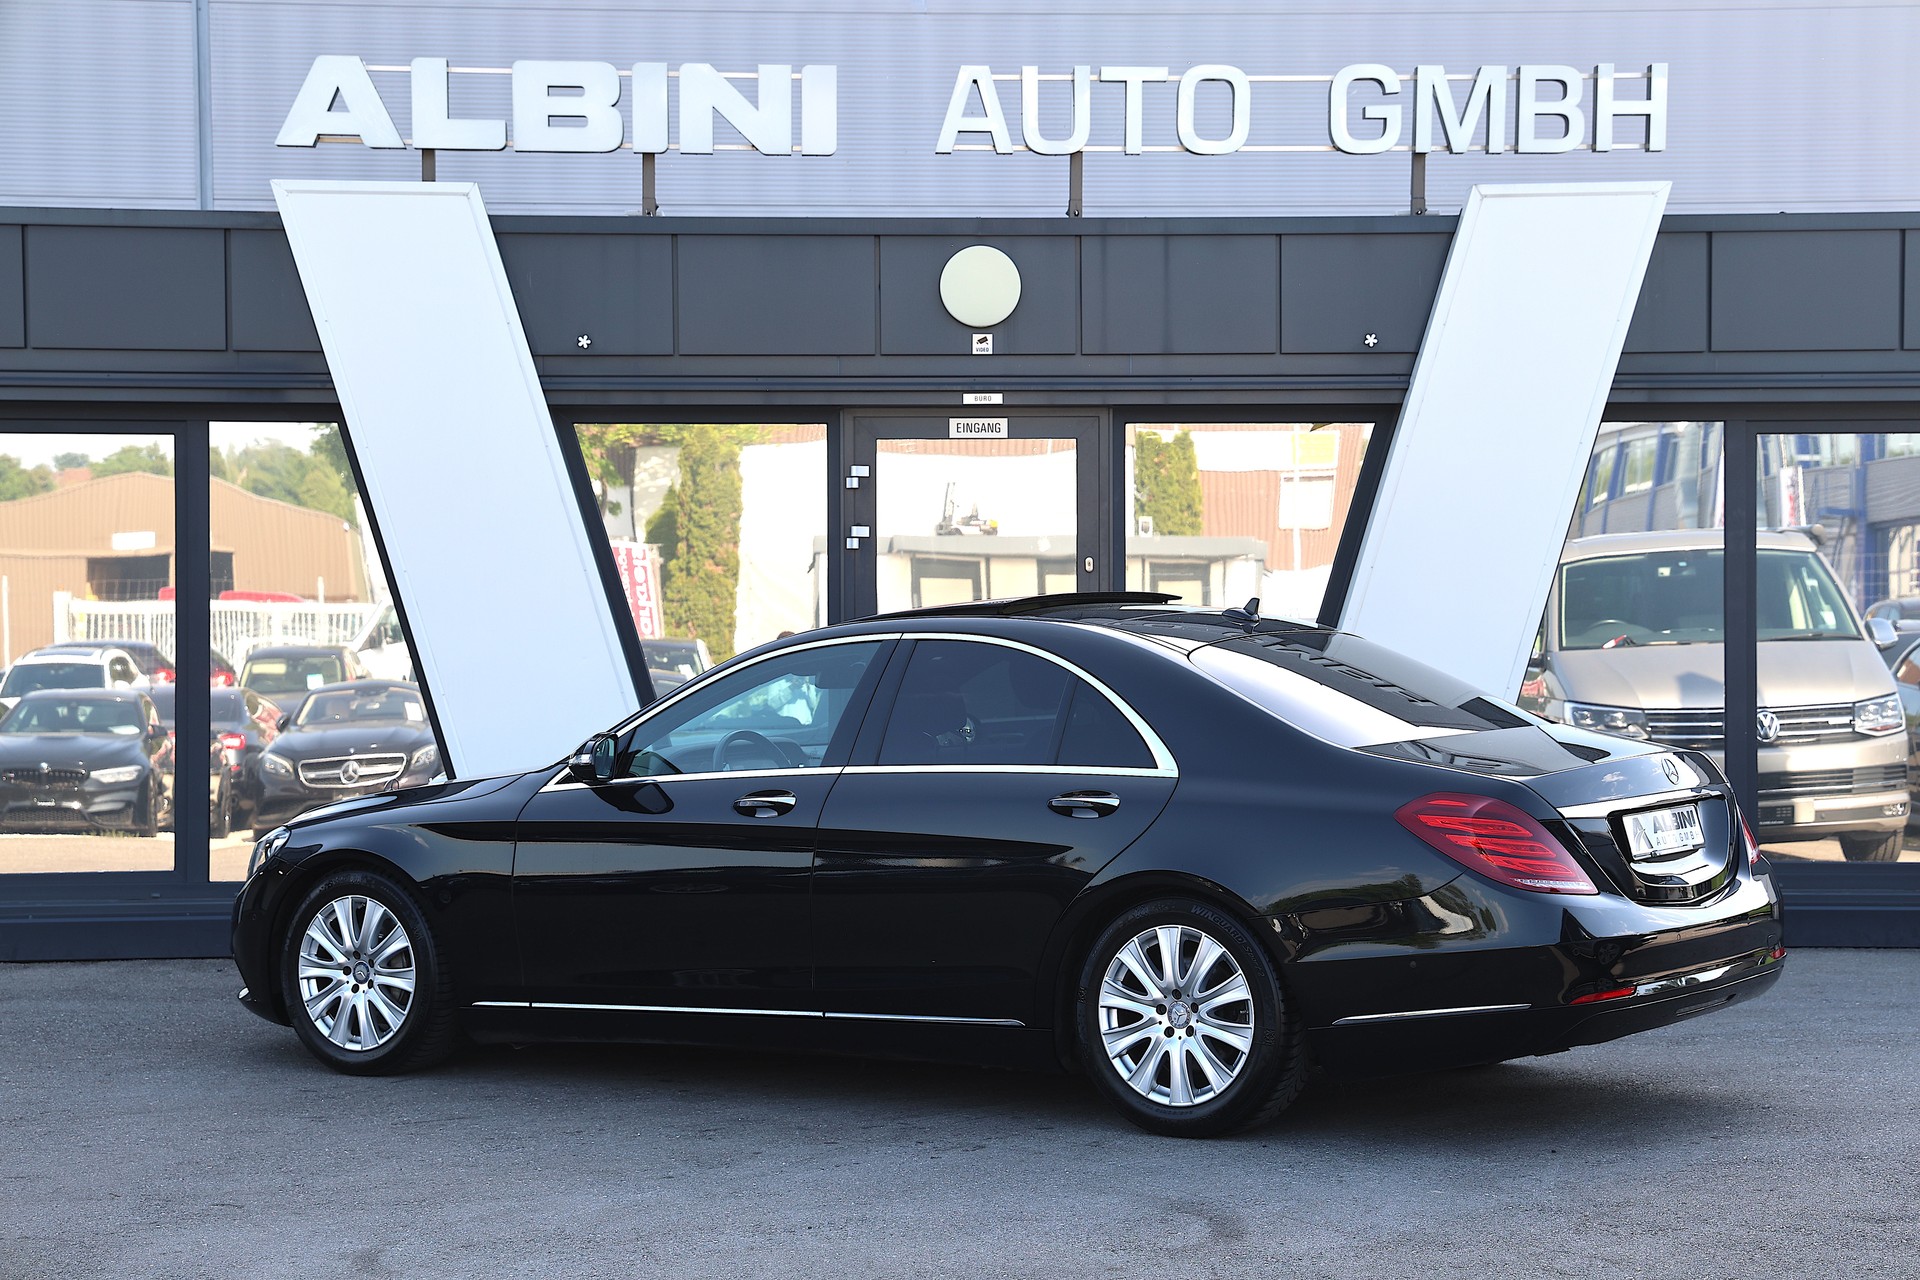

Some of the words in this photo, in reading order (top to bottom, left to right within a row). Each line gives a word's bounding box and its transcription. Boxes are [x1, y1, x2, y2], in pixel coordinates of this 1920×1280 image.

[275, 54, 837, 157] ALBINI
[934, 64, 1251, 156] AUTO
[1328, 63, 1668, 155] GMBH
[956, 422, 1001, 433] EINGANG
[1190, 904, 1246, 944] WINGUARD
